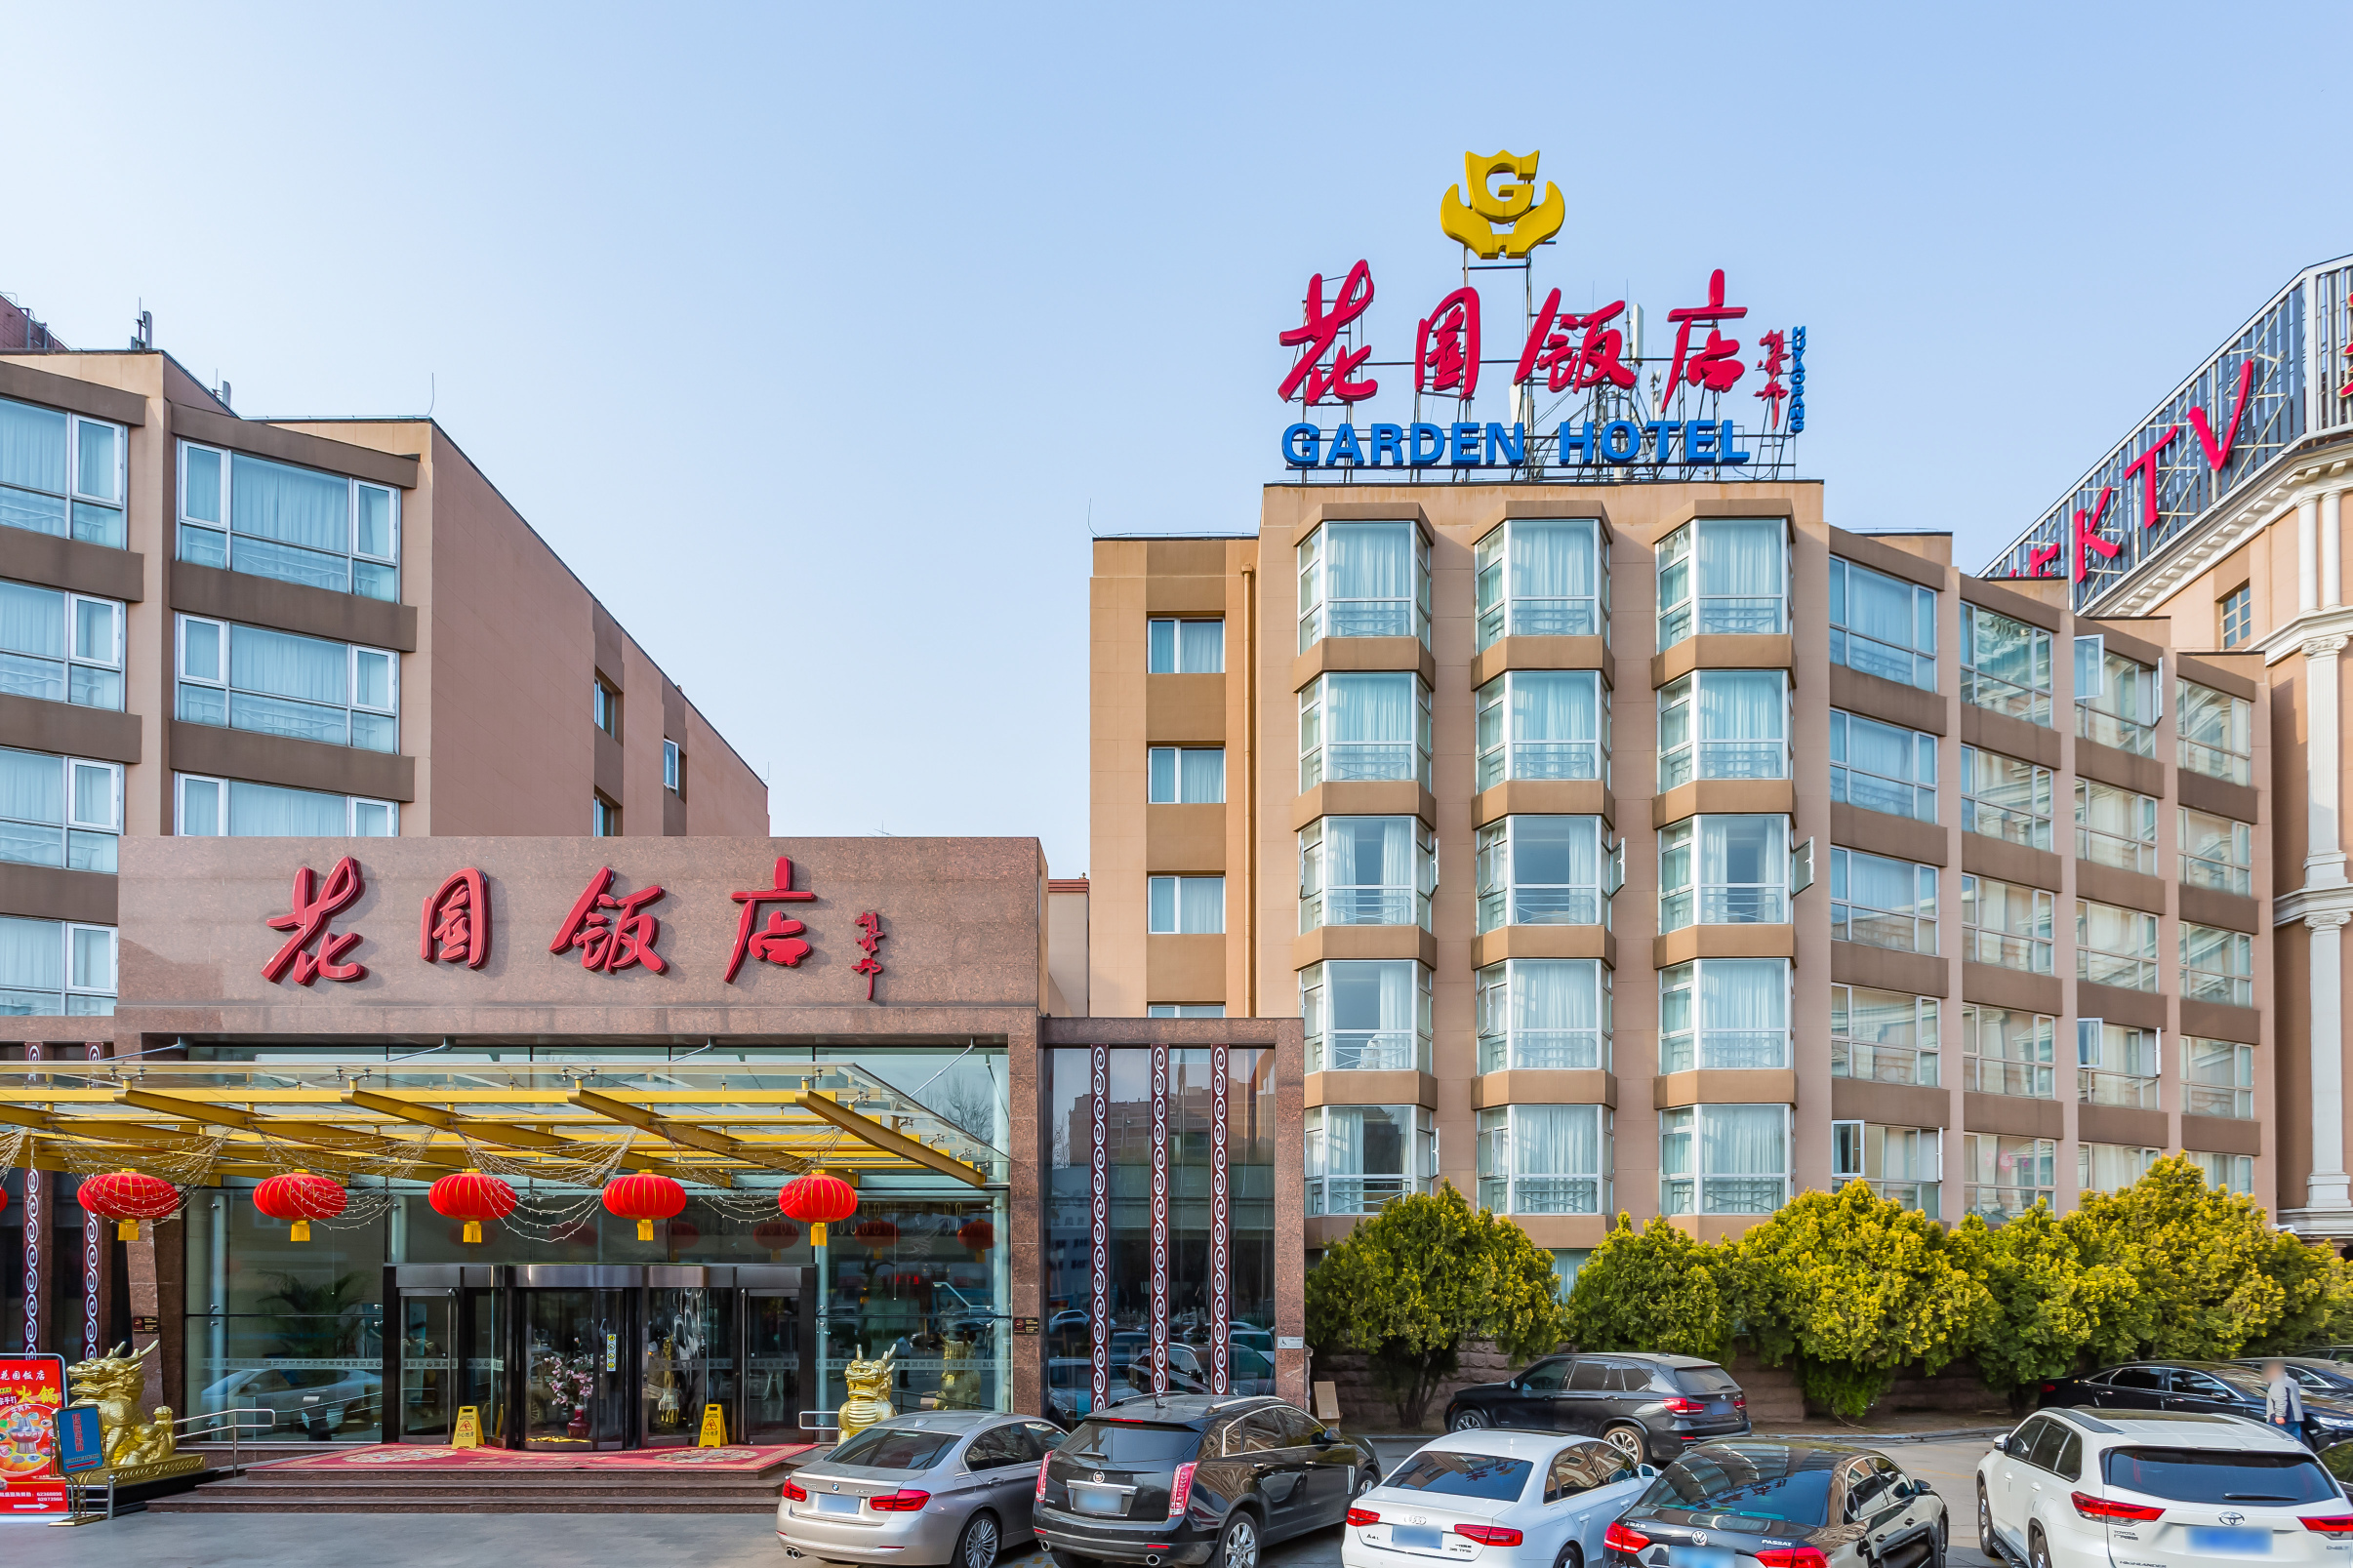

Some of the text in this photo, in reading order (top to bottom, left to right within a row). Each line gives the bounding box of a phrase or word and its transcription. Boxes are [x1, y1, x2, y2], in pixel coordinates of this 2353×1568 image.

[1278, 259, 1748, 413] 花园饭店
[1789, 326, 1805, 433] HUYAOBANG
[1281, 419, 1751, 467] GARDEN HOTEL
[2073, 359, 2253, 583] KTV
[261, 855, 818, 985] 花园饭店
[0, 1369, 46, 1381] 花园饭店
[15, 1386, 59, 1405] 火锅
